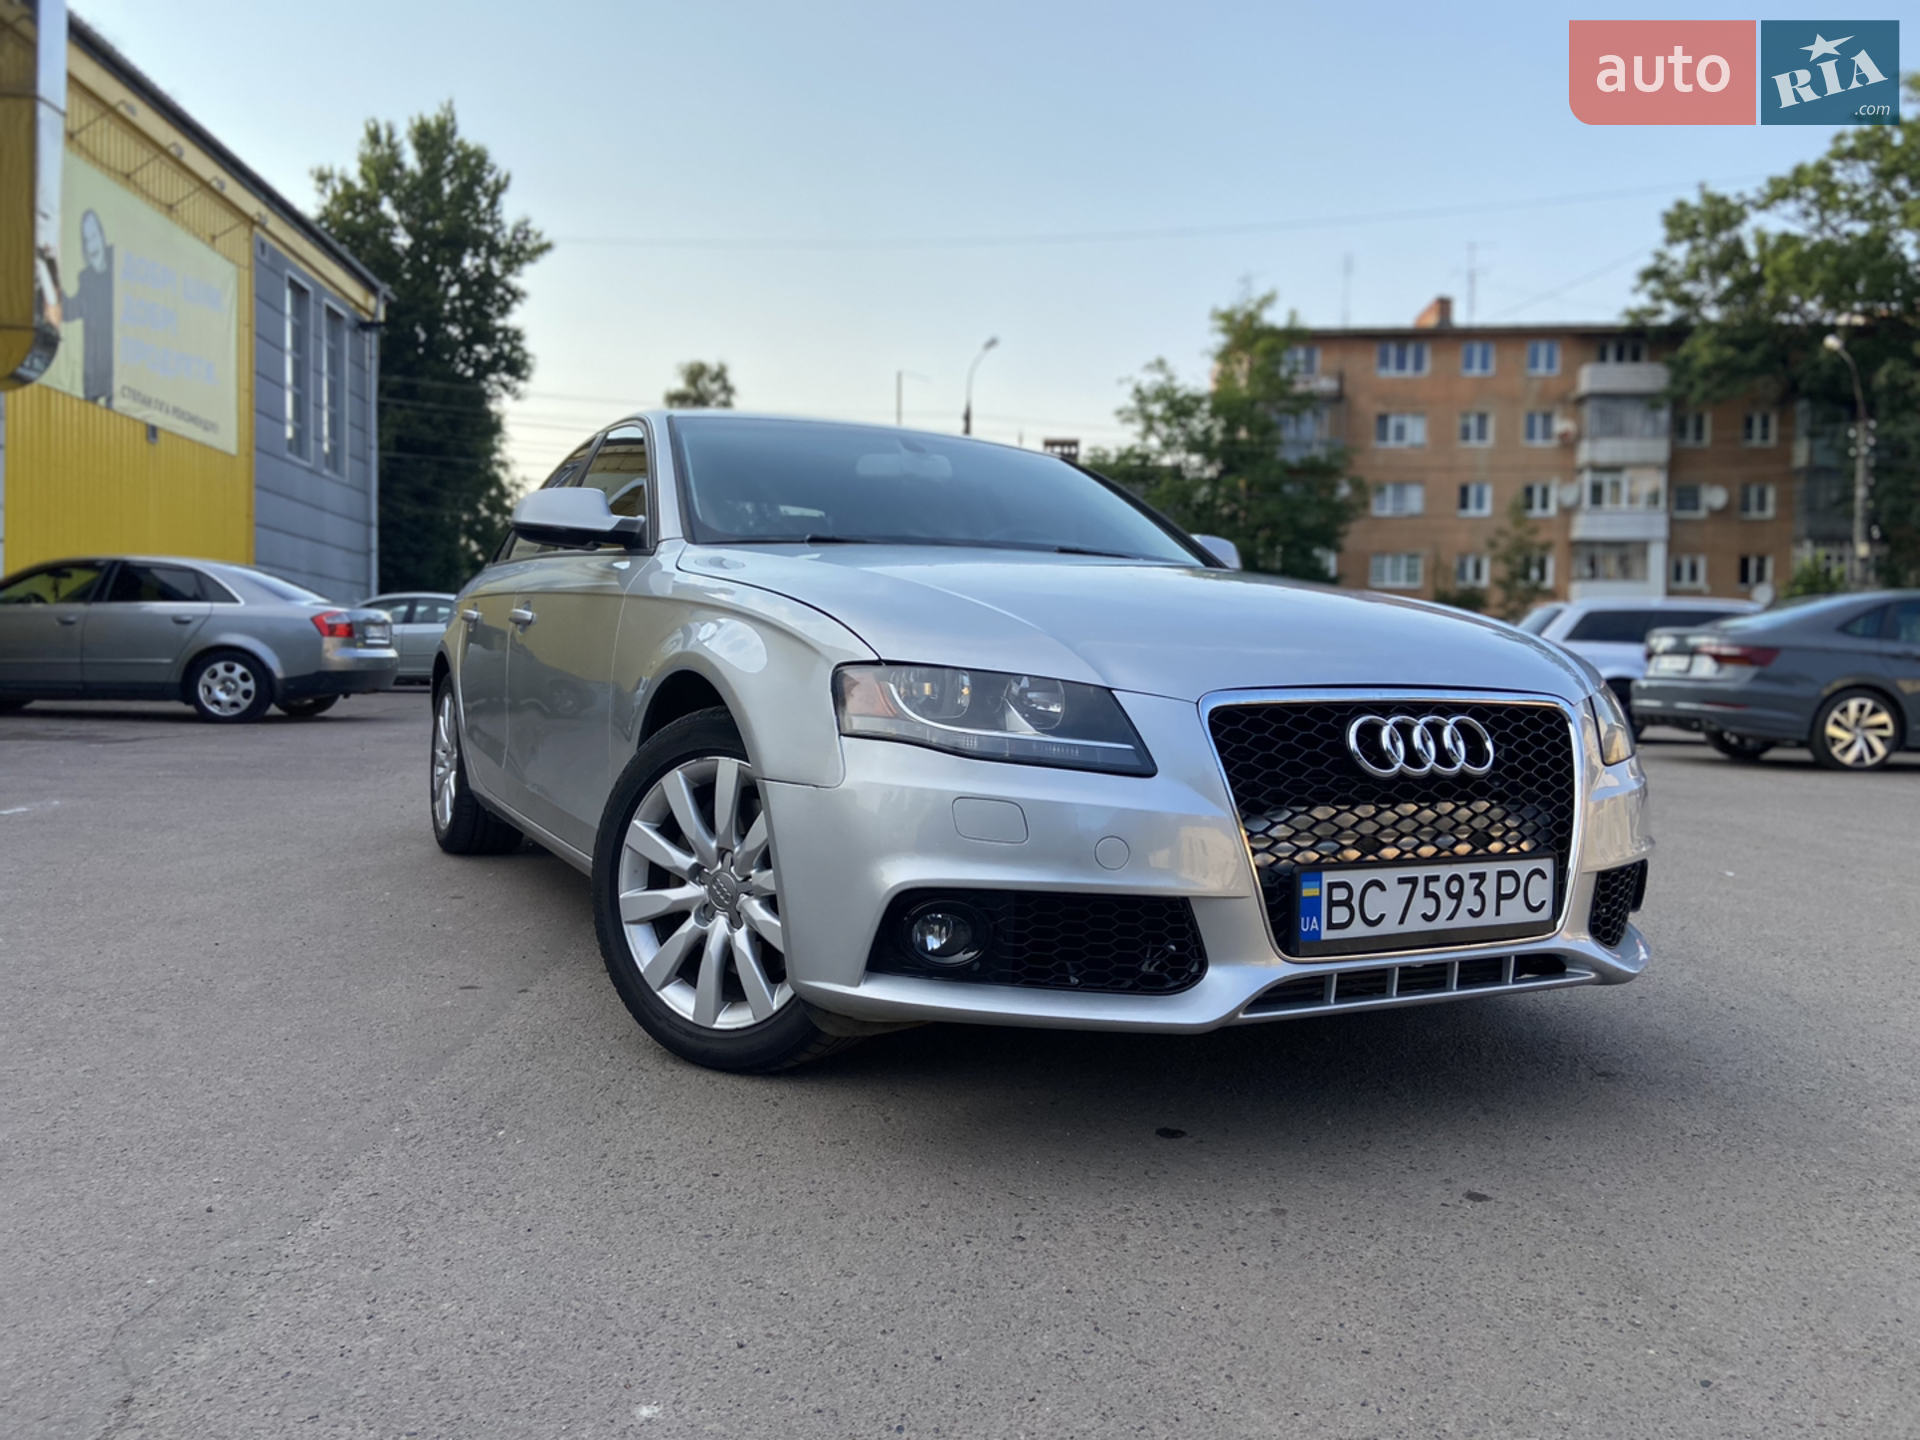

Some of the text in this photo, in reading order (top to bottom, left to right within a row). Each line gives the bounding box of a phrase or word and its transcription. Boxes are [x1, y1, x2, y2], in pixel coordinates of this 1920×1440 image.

[1326, 868, 1548, 931] BC 7593 PC
[1301, 916, 1319, 932] UA
